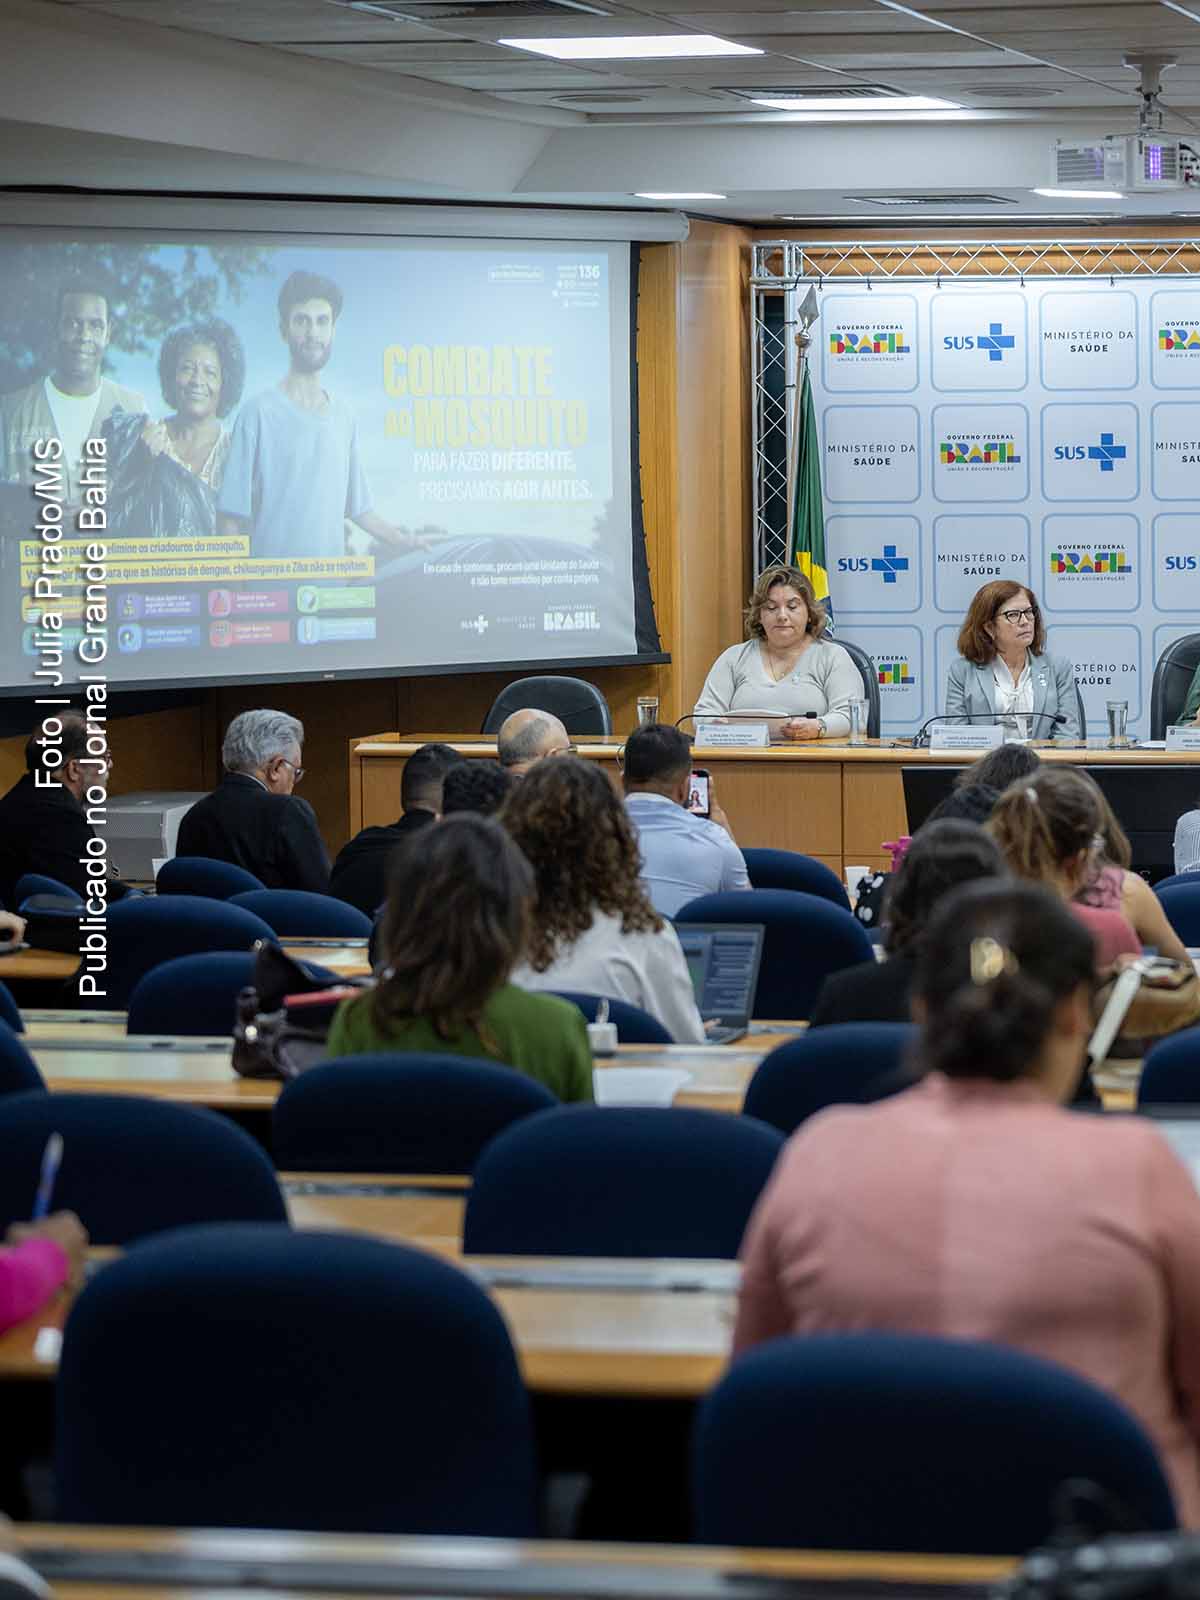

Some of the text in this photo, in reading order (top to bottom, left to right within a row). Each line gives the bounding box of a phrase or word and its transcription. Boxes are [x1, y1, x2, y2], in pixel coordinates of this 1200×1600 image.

[580, 264, 600, 280] 136
[1118, 330, 1135, 340] DA
[831, 334, 910, 353] BRASIL
[945, 336, 974, 350] SUS
[1069, 342, 1109, 353] SAÚDE
[383, 345, 554, 397] COMBATE
[414, 399, 590, 449] MOSQUITO
[900, 443, 917, 453] DA
[941, 443, 1021, 463] BRASIL
[1055, 446, 1084, 460] SUS
[853, 455, 891, 466] SAÚDE
[838, 557, 867, 571] SUS
[1011, 553, 1027, 563] DA
[1051, 552, 1131, 573] BRASIL
[1166, 556, 1195, 570] SUS
[963, 565, 1001, 576] SAÚDE
[543, 611, 601, 631] BRASIL
[878, 662, 915, 685] SIL
[1121, 663, 1137, 672] DA
